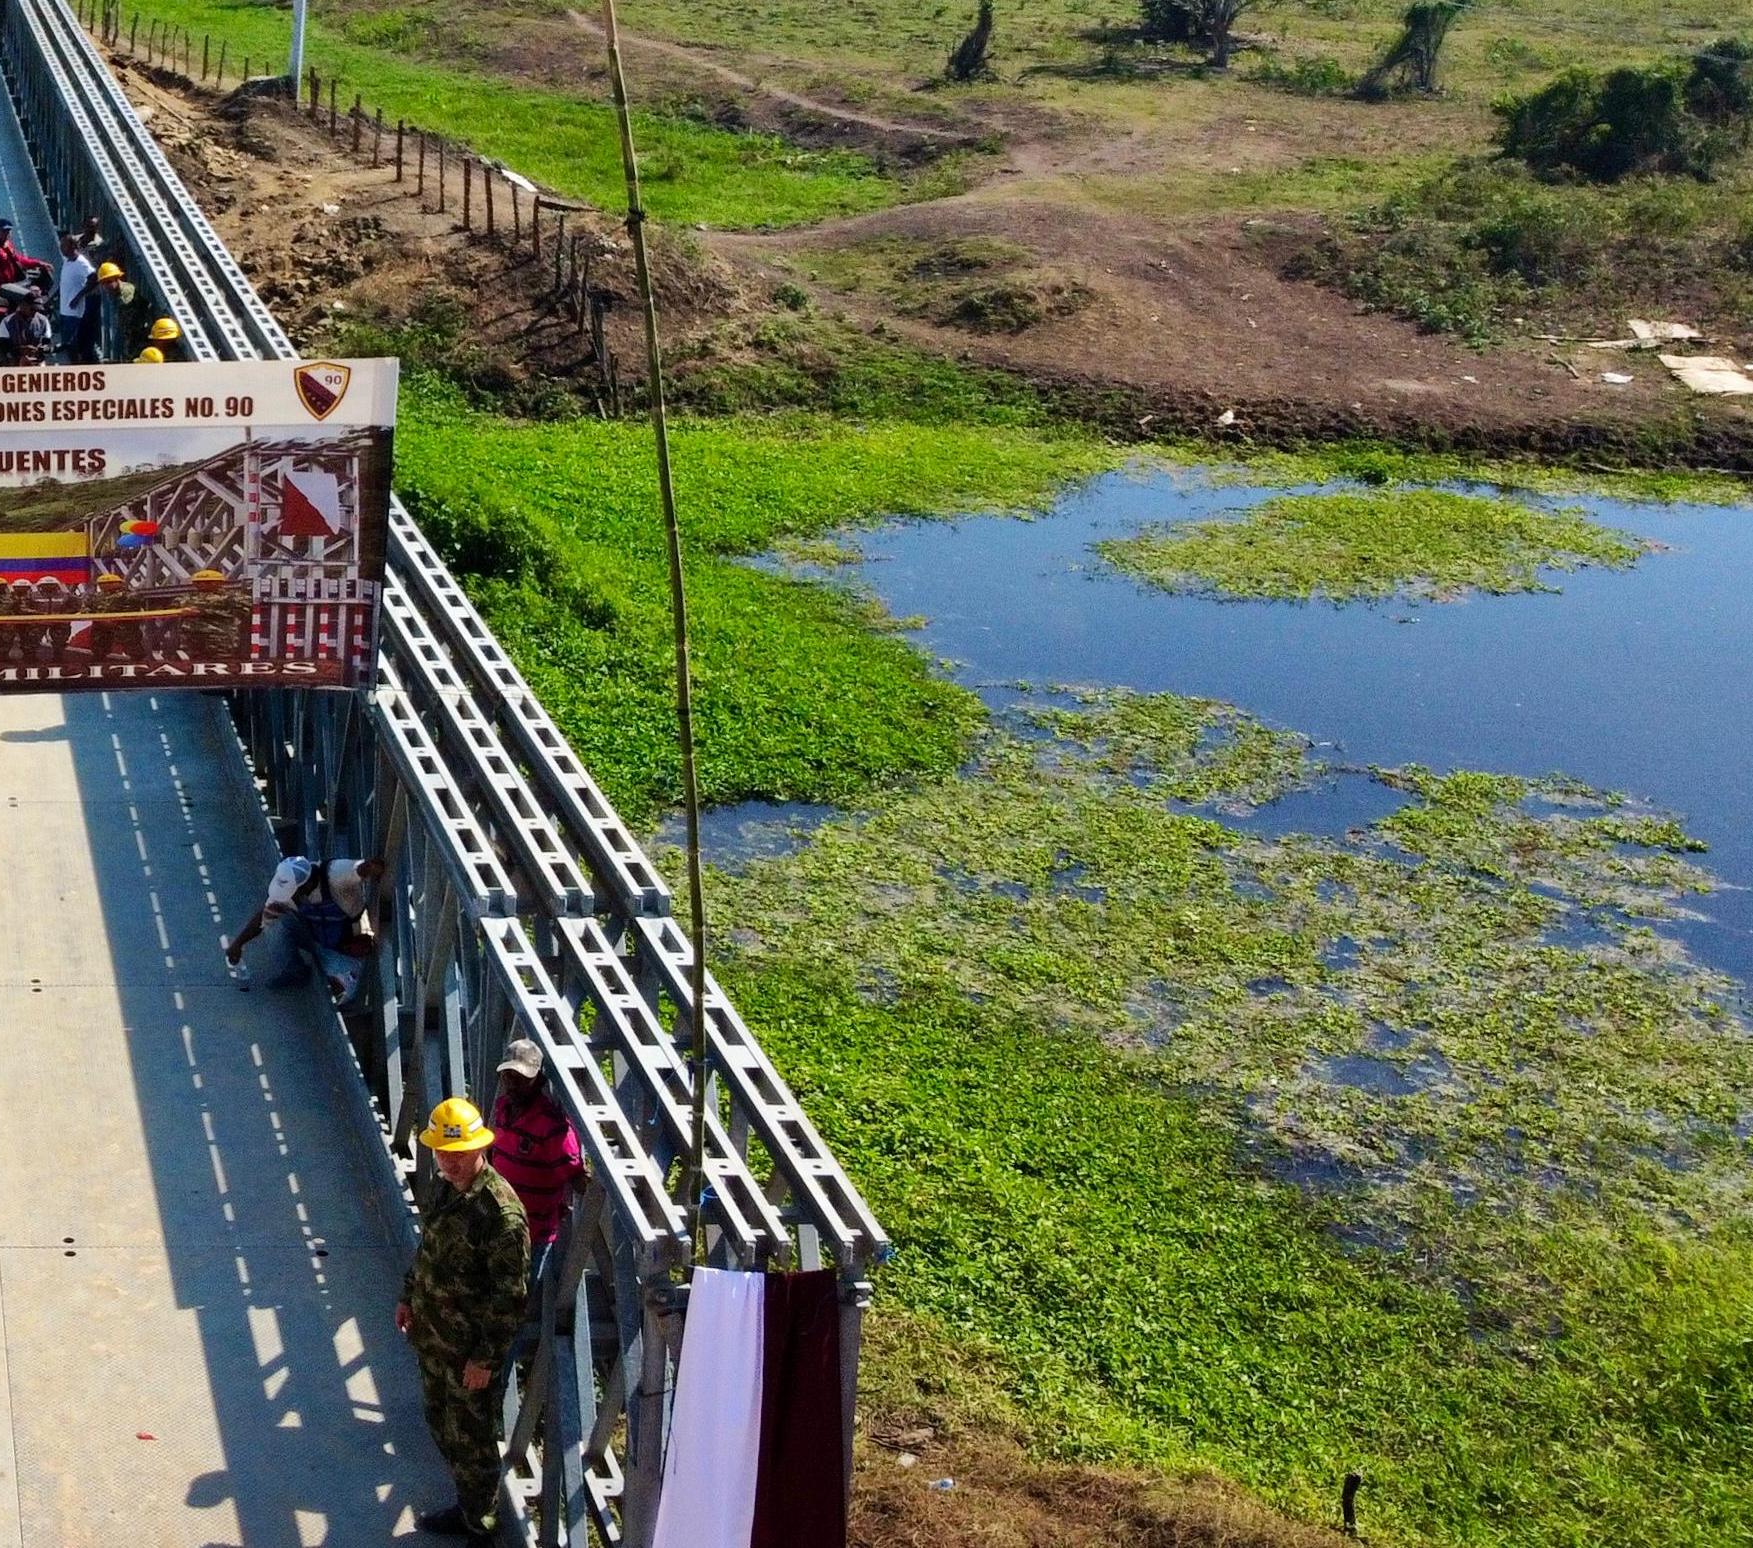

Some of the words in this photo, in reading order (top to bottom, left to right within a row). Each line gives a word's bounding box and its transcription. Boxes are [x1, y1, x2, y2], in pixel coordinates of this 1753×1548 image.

[324, 375, 342, 385] 90
[51, 398, 174, 421] ESPECIALES
[184, 397, 219, 418] NO.
[224, 396, 254, 417] 90
